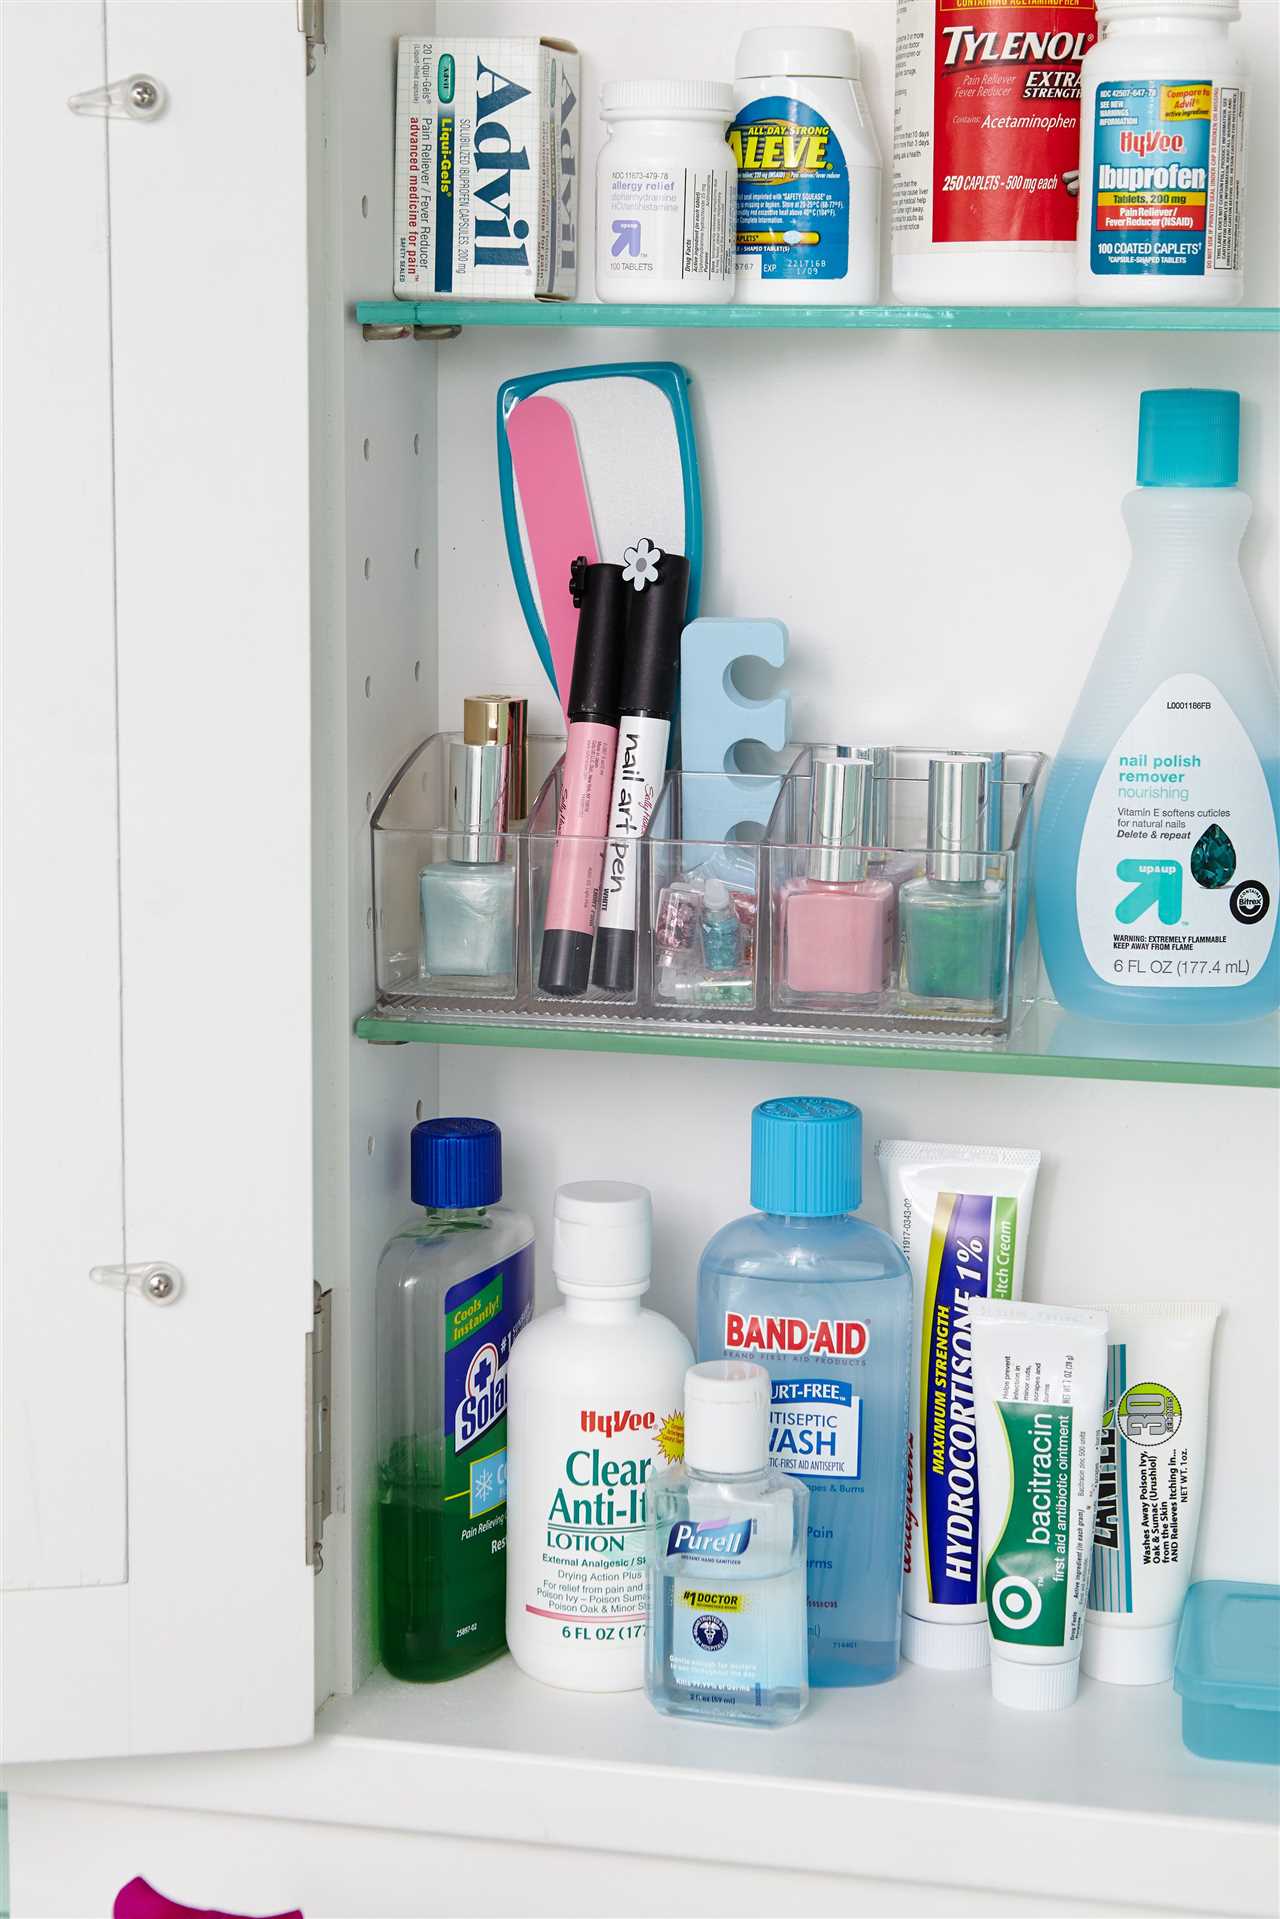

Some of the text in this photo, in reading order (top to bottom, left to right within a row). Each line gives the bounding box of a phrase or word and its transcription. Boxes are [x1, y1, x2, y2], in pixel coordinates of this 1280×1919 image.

[422, 44, 432, 54] 20
[942, 26, 1085, 64] TYLENOL
[963, 74, 1016, 85] Pain Reliever
[954, 86, 1012, 98] Fever Reducer
[790, 126, 829, 135] STRONG
[981, 114, 1076, 132] Acetaminophen
[473, 55, 532, 267] Advil
[612, 181, 674, 192] allergy relief
[942, 174, 1057, 193] 250 CAPLETS 500 mg each
[1099, 163, 1206, 192] Ibuprofen
[406, 117, 420, 274] advanced medicine for pain
[420, 118, 432, 269] Pain Reliever Fever Reducer
[1150, 195, 1170, 204] 200
[1171, 196, 1186, 204] mg
[1120, 208, 1138, 217] Pain
[1106, 217, 1194, 227] Fever Reducer (NSAID)
[458, 248, 468, 262] 200
[684, 239, 692, 272] Drug Facts
[1098, 243, 1152, 254] 100 COATED
[456, 262, 466, 274] mg
[764, 264, 776, 272] EXP
[1119, 754, 1201, 769] nail polish
[1119, 771, 1185, 783] remover
[1118, 786, 1189, 801] nourishing
[610, 734, 645, 894] nail art pen
[1118, 808, 1230, 818] Vitamin E softens cuticles
[1118, 818, 1186, 828] for natural nails
[1117, 830, 1191, 841] Delete & repeat
[1113, 934, 1226, 944] WARNING: EXTREMELY FLAMMABLE
[1113, 942, 1194, 951] KEEP AWAY FROM FLAME
[1114, 960, 1250, 976] 6 FL OZ (177.4 mL)
[997, 1220, 1011, 1265] Cream
[956, 1239, 984, 1281] 1%
[452, 1296, 500, 1340] Instantly!
[454, 1300, 480, 1325] Cools
[727, 1314, 866, 1355] BAND-AID
[1004, 1356, 1012, 1380] prevent
[772, 1383, 840, 1400] URT-FREE
[932, 1305, 950, 1476] MAXIMUM STRENGTH
[462, 1376, 508, 1441] Sola
[1126, 1393, 1168, 1436] 30
[580, 1410, 655, 1438] HyVee
[770, 1412, 838, 1428] TISEPTIC
[566, 1448, 652, 1486] Clear
[798, 1460, 845, 1472] AID ANTISEPTIC
[1179, 1448, 1188, 1502] NET WT. 1oz.
[1026, 1413, 1052, 1545] bacitracin
[1148, 1456, 1159, 1501] (Urushiol)
[1053, 1415, 1070, 1582] first aid antibiotic ointment
[1139, 1450, 1152, 1564] Washes Away Poison Ivy,
[1168, 1448, 1179, 1562] AND Relieves Itching in...
[1150, 1503, 1160, 1534] Sumac
[461, 1523, 478, 1542] Pain
[546, 1531, 624, 1552] LOTION
[674, 1524, 741, 1552] Purell
[1160, 1502, 1169, 1563] from the Skin
[542, 1554, 628, 1569] External Analgesic
[1151, 1545, 1160, 1564] Oak
[558, 1570, 642, 1582] Drying Action Plus
[537, 1588, 620, 1604] Poison Ivy Poison
[544, 1580, 643, 1595] For relief from pain and
[549, 1600, 636, 1614] Poison Oak & Minor
[684, 1591, 696, 1606] #1
[698, 1592, 738, 1605] DOCTOR
[562, 1626, 615, 1640] 6 FL OZ
